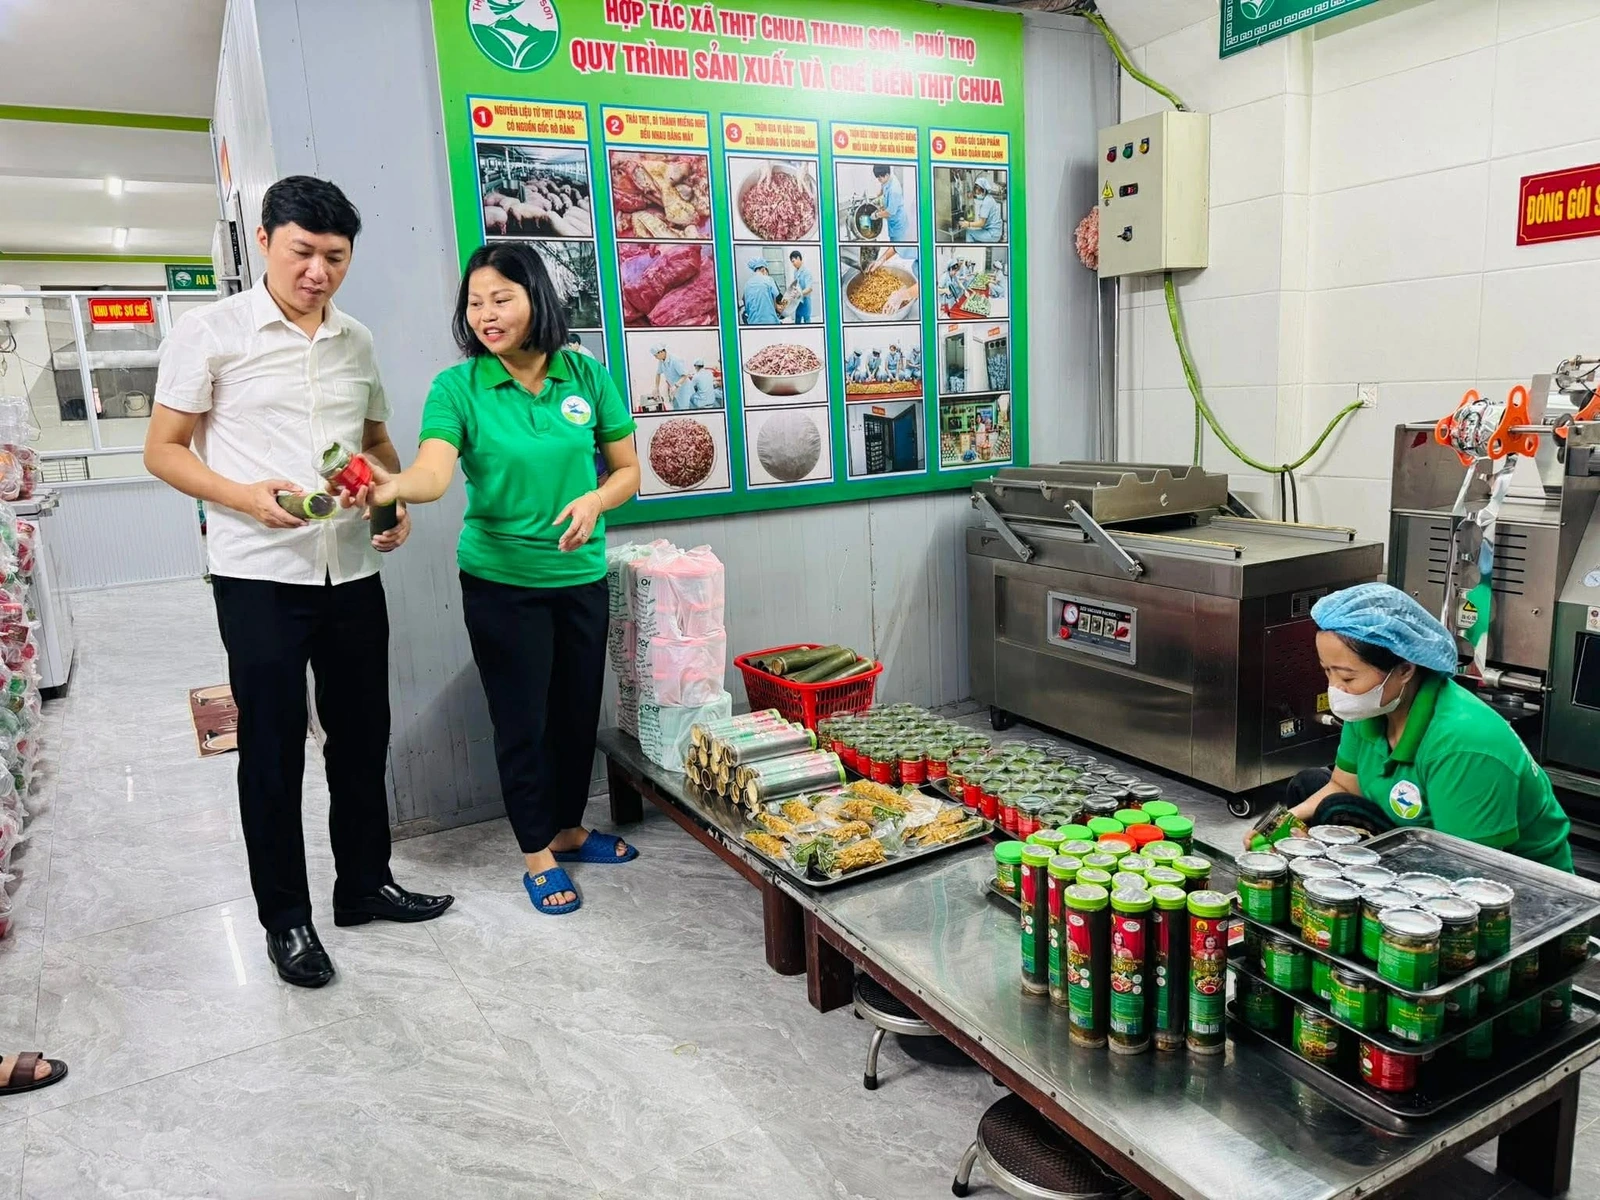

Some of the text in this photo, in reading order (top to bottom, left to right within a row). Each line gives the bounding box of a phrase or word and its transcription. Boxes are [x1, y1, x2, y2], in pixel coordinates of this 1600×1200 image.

[605, 0, 645, 31] HỢP
[649, 0, 685, 30] TÁC
[689, 4, 717, 34] XÃ
[718, 10, 757, 42] THỊT
[761, 15, 808, 44] CHUA
[810, 21, 864, 49] THANH
[868, 26, 900, 53] SƠN
[914, 31, 945, 58] PHÚ
[947, 36, 976, 65] THỌ
[571, 39, 1003, 105] QUY TRÌNH SẢN XUẤT VÀ CHẾ BIẾN THỊT CHUA
[478, 110, 487, 124] 1
[610, 119, 620, 132] 2
[730, 127, 739, 139] 3
[838, 134, 845, 146] 4
[935, 140, 943, 151] 5
[1526, 187, 1564, 225] ĐÓNG
[1566, 180, 1592, 220] GÓI
[195, 274, 210, 285] AN
[93, 300, 149, 319] KHU VỰC SƠ CHẾ
